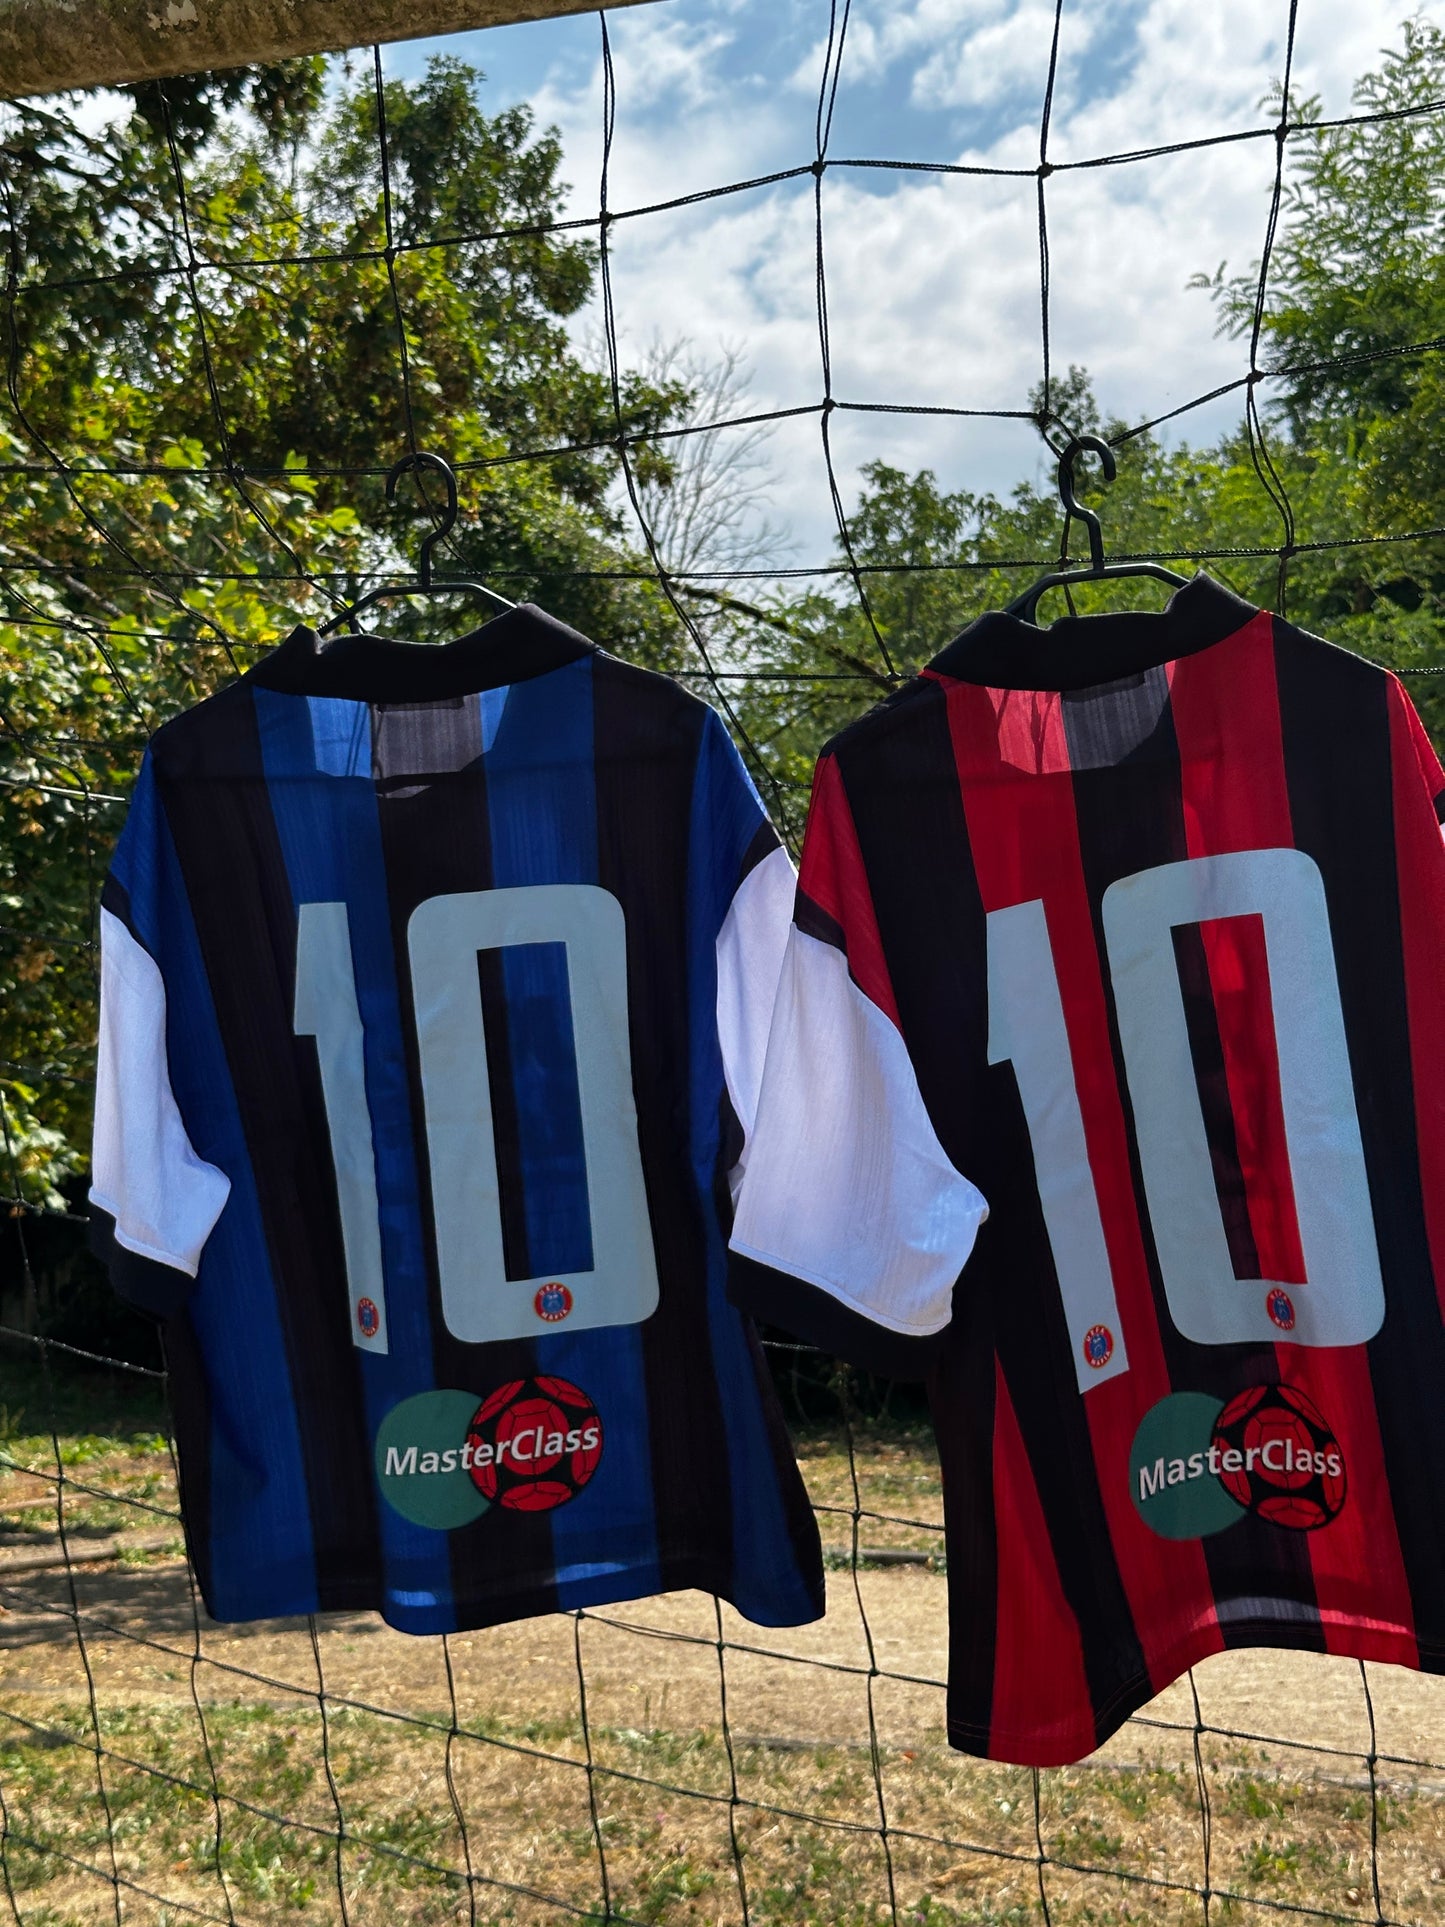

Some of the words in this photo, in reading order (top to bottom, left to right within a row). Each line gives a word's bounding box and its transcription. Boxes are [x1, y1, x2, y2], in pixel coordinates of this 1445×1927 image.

[294, 884, 660, 1354] 10
[987, 848, 1386, 1394] 10
[385, 1425, 600, 1476] MasterClass
[1138, 1438, 1342, 1501] MasterClass
